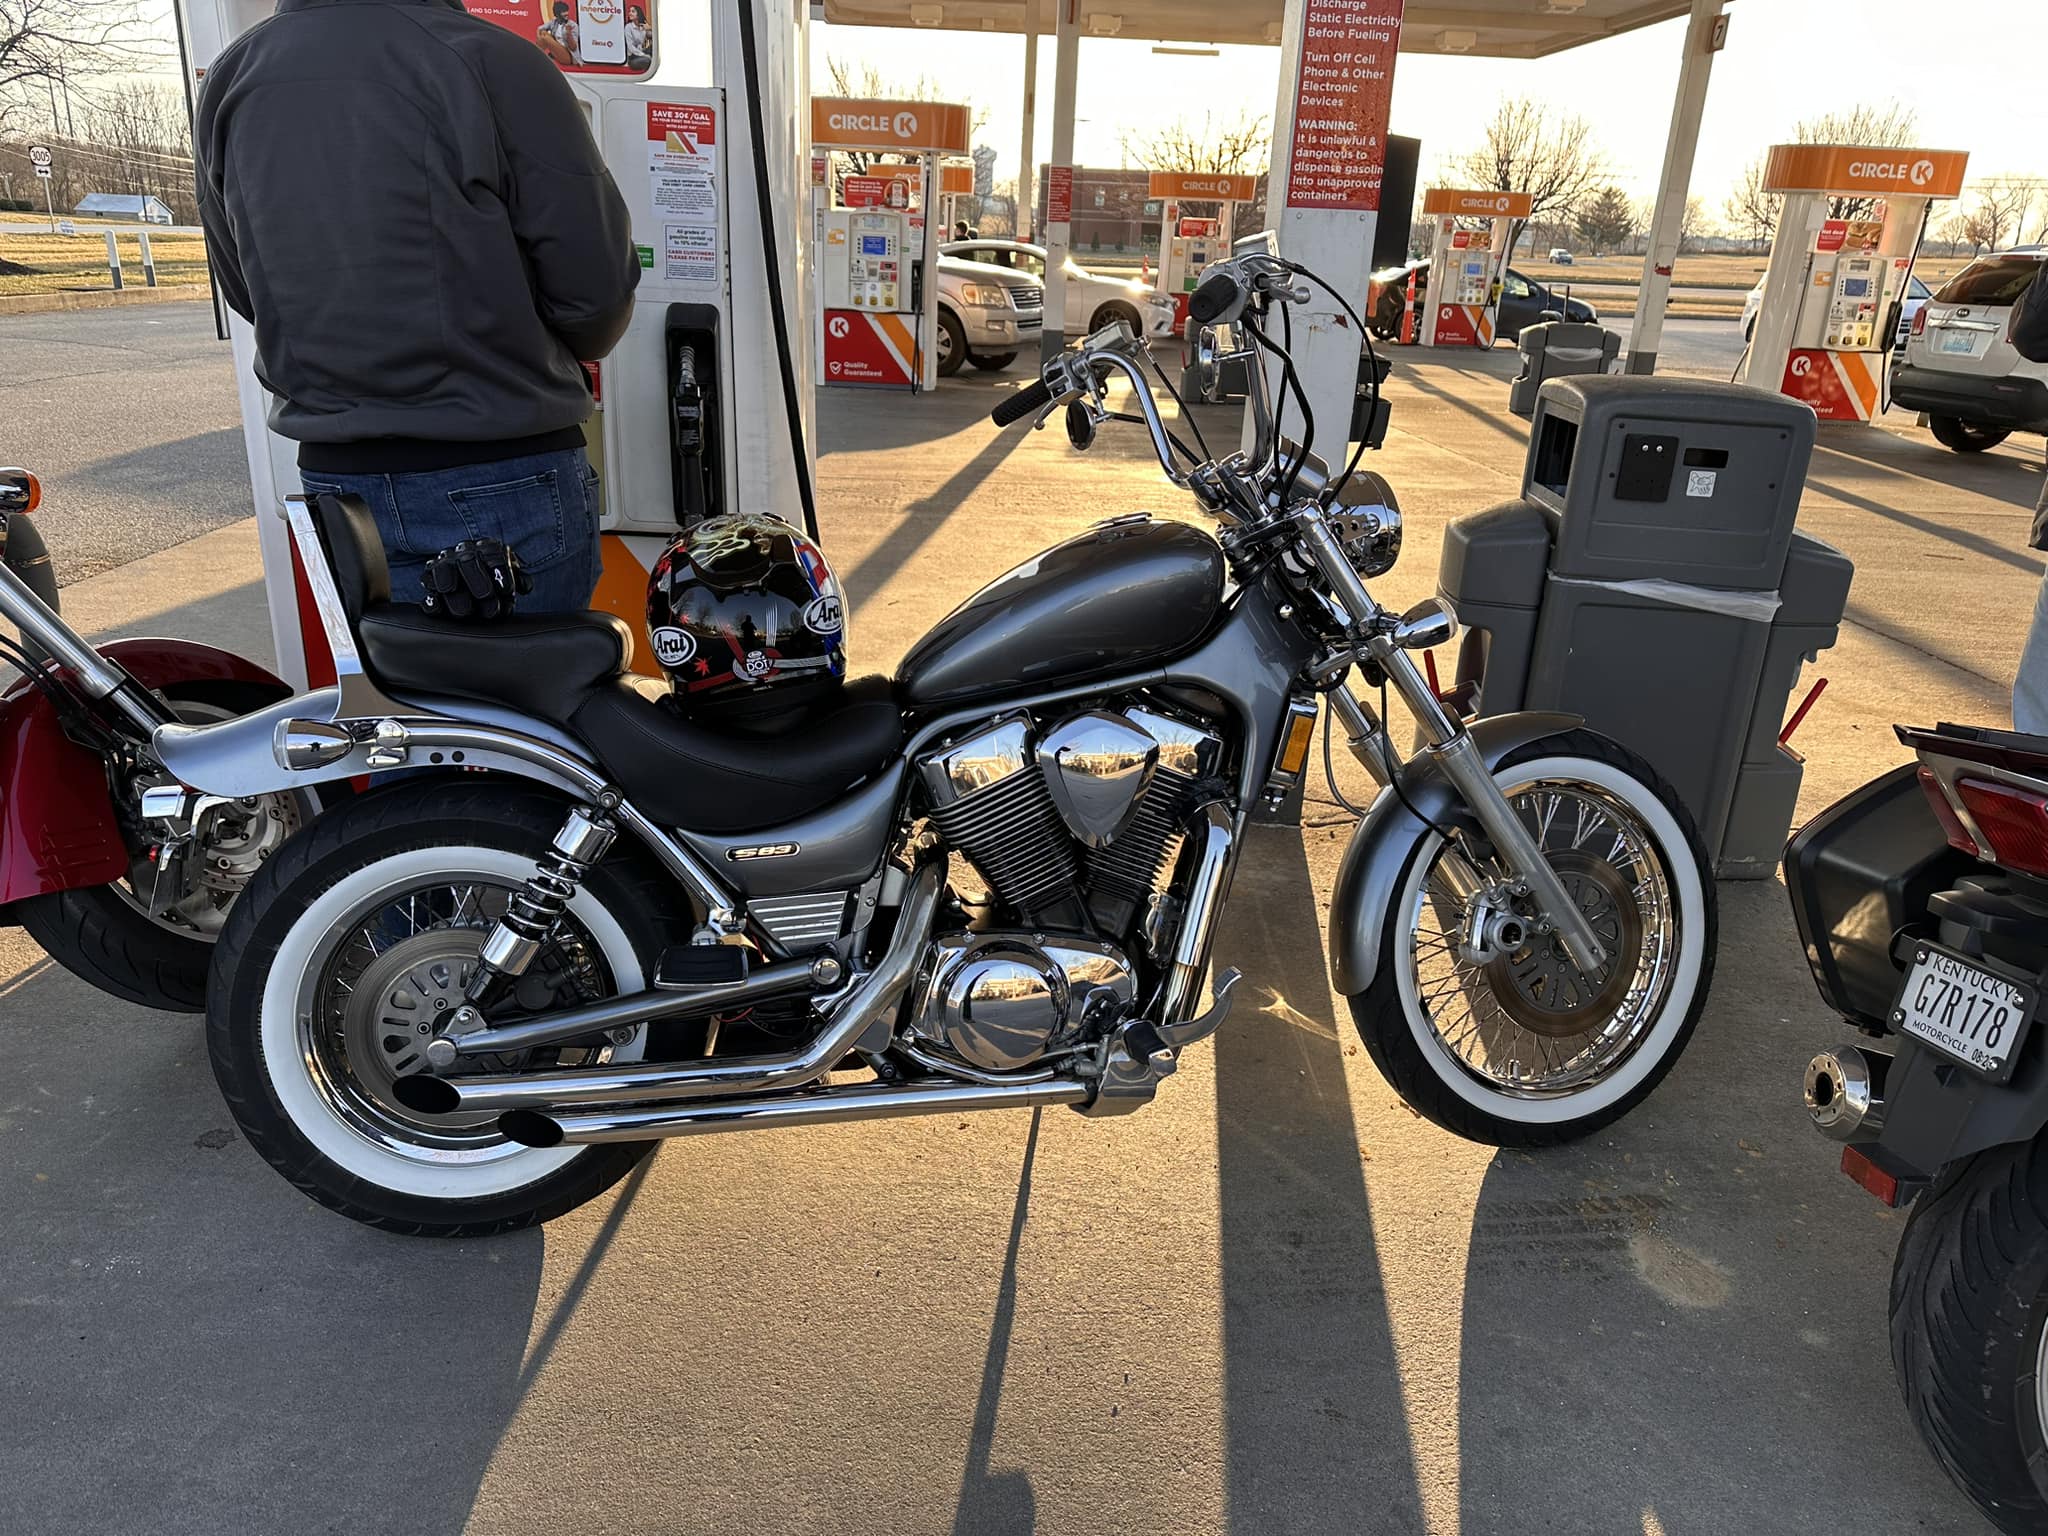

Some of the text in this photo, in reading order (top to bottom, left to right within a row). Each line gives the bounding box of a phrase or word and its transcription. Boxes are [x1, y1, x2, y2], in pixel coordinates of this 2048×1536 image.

[1310, 0, 1367, 11] Discharge
[1310, 12, 1400, 28] Static Electricity
[1308, 27, 1390, 42] Before Fueling
[1306, 51, 1376, 64] Turn Off Cell
[1304, 66, 1384, 79] Phone & Other
[1302, 80, 1358, 93] Electronic
[1301, 95, 1344, 106] Devices
[652, 110, 672, 118] SAVE
[828, 112, 918, 138] CIRCLE K
[1299, 119, 1358, 131] WARNING:
[1297, 133, 1376, 146] It is unlawful &
[32, 150, 50, 162] 3005
[1296, 148, 1368, 160] dangerous to
[1294, 161, 1384, 175] dispense gasolin
[1848, 160, 1934, 186] CIRCLE K
[1182, 180, 1231, 194] CIRCLE K
[1292, 175, 1382, 189] into unapproved
[1291, 190, 1348, 200] containers
[1460, 197, 1510, 212] CIRCLE K
[1441, 307, 1453, 320] K
[829, 316, 849, 338] K
[844, 361, 868, 369] Quality
[1791, 356, 1811, 376] K
[844, 369, 882, 377] Guaranteed
[656, 632, 687, 654] Arai
[747, 660, 770, 672] DOT
[1933, 956, 2016, 1001] KENTUCKY
[1914, 974, 2008, 1048] G7R178
[1912, 1020, 1968, 1053] MOTORCYCLE
